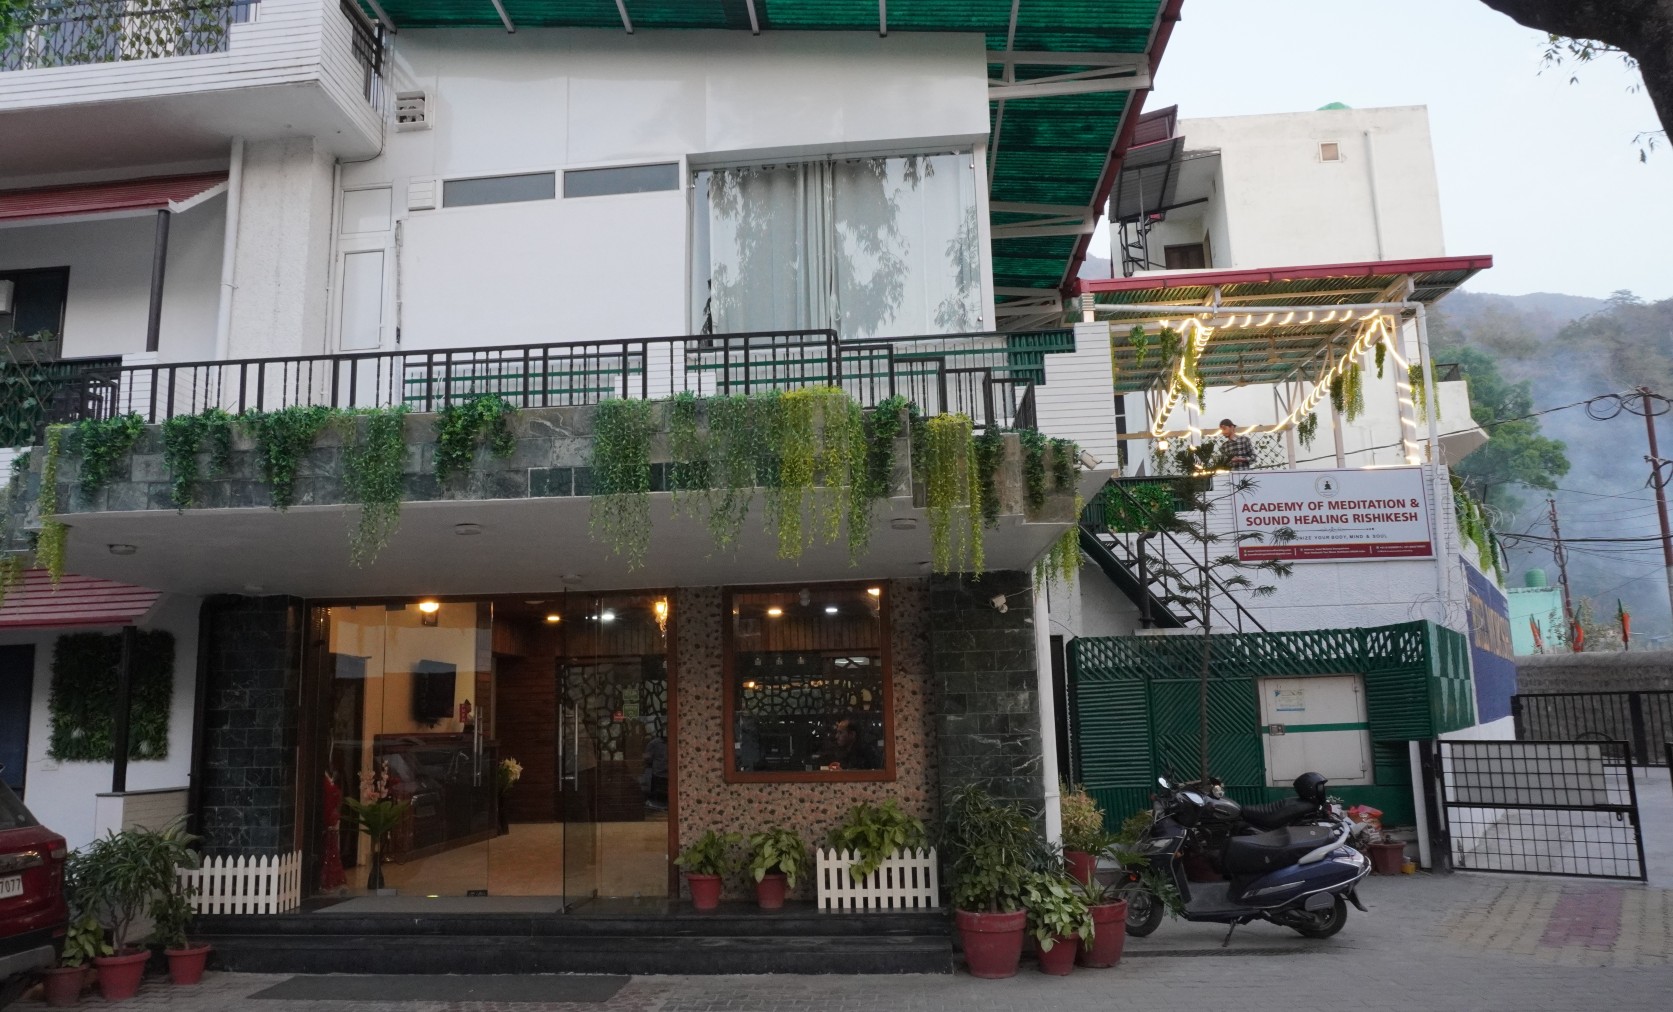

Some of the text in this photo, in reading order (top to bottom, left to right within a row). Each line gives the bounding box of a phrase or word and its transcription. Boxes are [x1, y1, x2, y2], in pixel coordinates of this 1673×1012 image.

[1242, 498, 1420, 513] ACADEMY OF MEDITATION &
[1246, 512, 1418, 526] SOUND HEALING RISHIKESH
